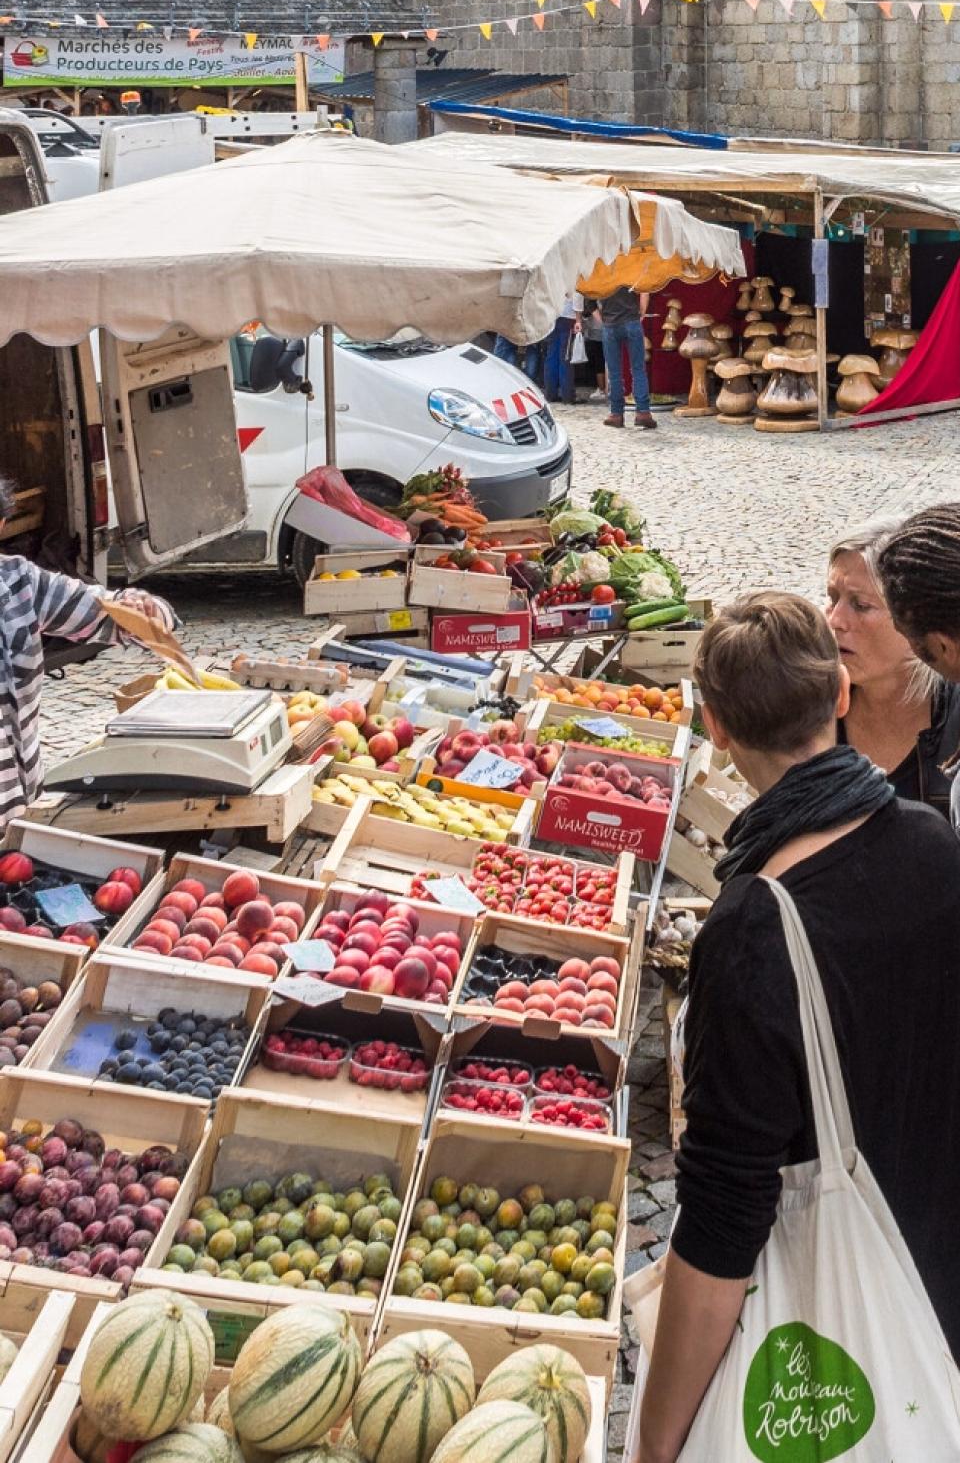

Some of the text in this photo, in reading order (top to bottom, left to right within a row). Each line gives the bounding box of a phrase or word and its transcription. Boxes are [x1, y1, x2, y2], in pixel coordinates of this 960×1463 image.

[57, 39, 164, 54] Marchés des
[57, 57, 224, 74] Producteurs de Pays
[231, 55, 249, 63] Tous
[445, 633, 498, 646] NAMISWE
[555, 815, 645, 846] NAMISWEET
[786, 1340, 811, 1381] les
